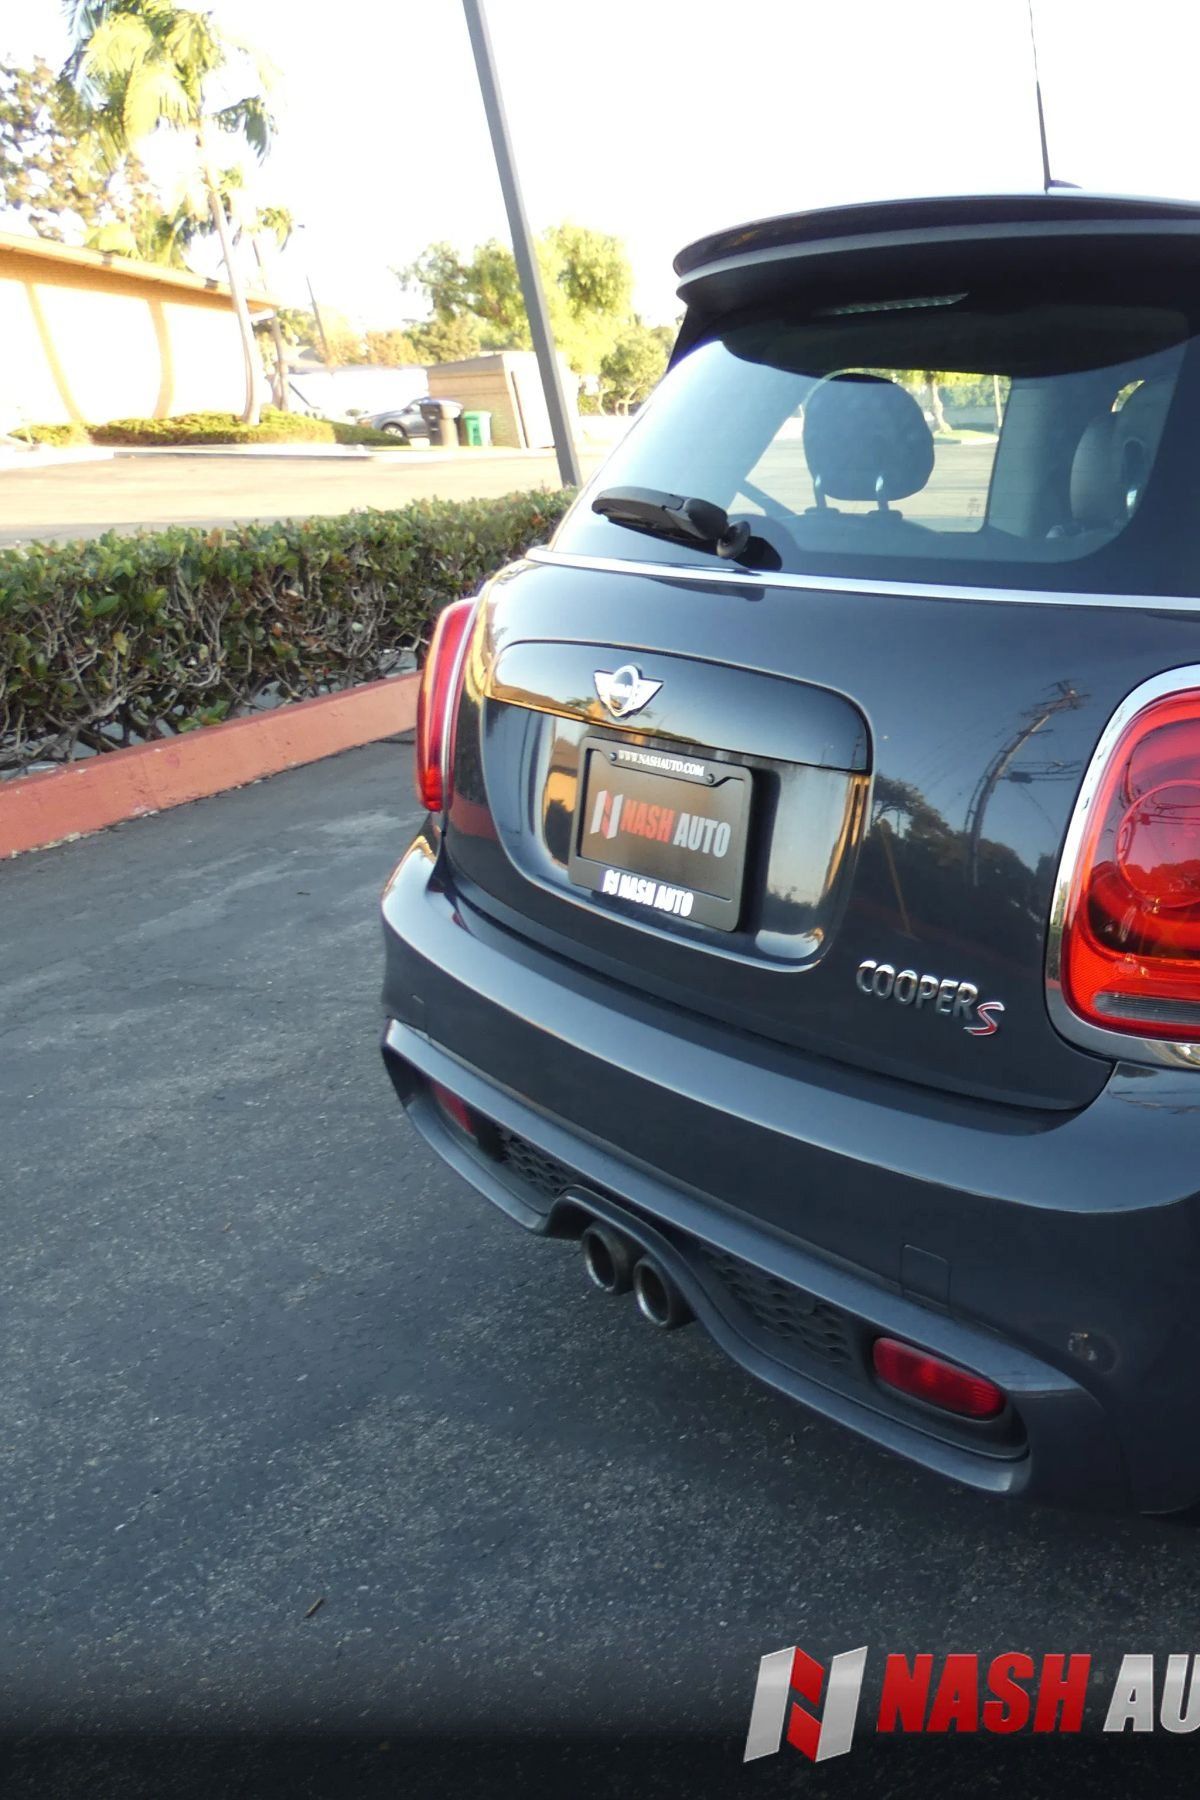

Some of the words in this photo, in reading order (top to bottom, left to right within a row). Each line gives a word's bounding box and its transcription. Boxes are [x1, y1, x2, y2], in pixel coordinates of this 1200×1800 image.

[618, 750, 705, 777] WWW.NASHAUTO.COM
[620, 799, 675, 843] NASH
[673, 812, 731, 858] AUTO
[617, 874, 657, 906] NASH
[653, 885, 694, 917] AUTO
[856, 960, 979, 1020] COOPER
[963, 1001, 1006, 1035] S
